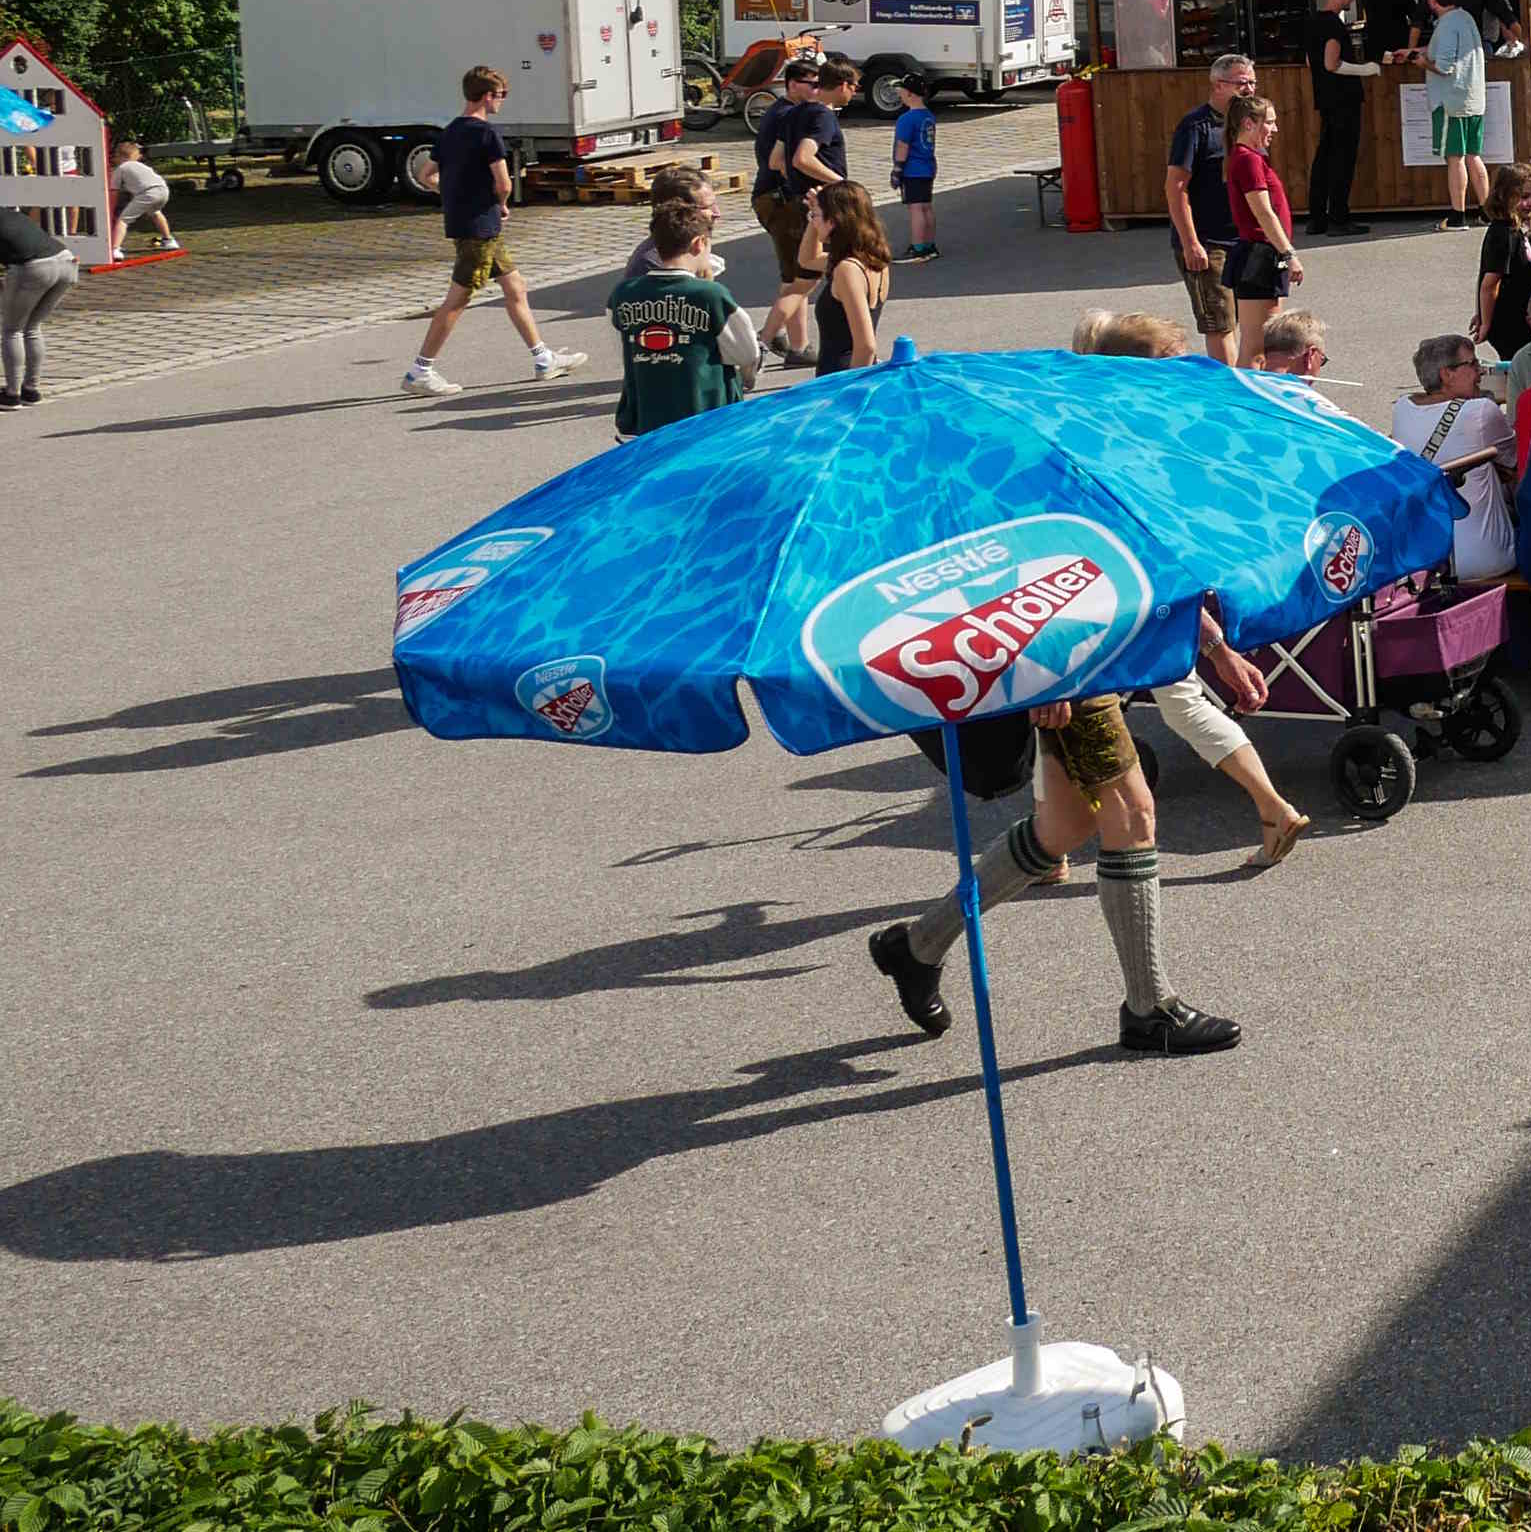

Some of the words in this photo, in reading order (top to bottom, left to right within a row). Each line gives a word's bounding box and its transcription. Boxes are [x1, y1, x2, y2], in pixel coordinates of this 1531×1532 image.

[620, 294, 712, 334] Brooklyn
[874, 538, 1010, 605] Nestlé
[1326, 528, 1361, 588] Schöller
[899, 558, 1097, 712] Schöller
[543, 683, 595, 730] Schöller
